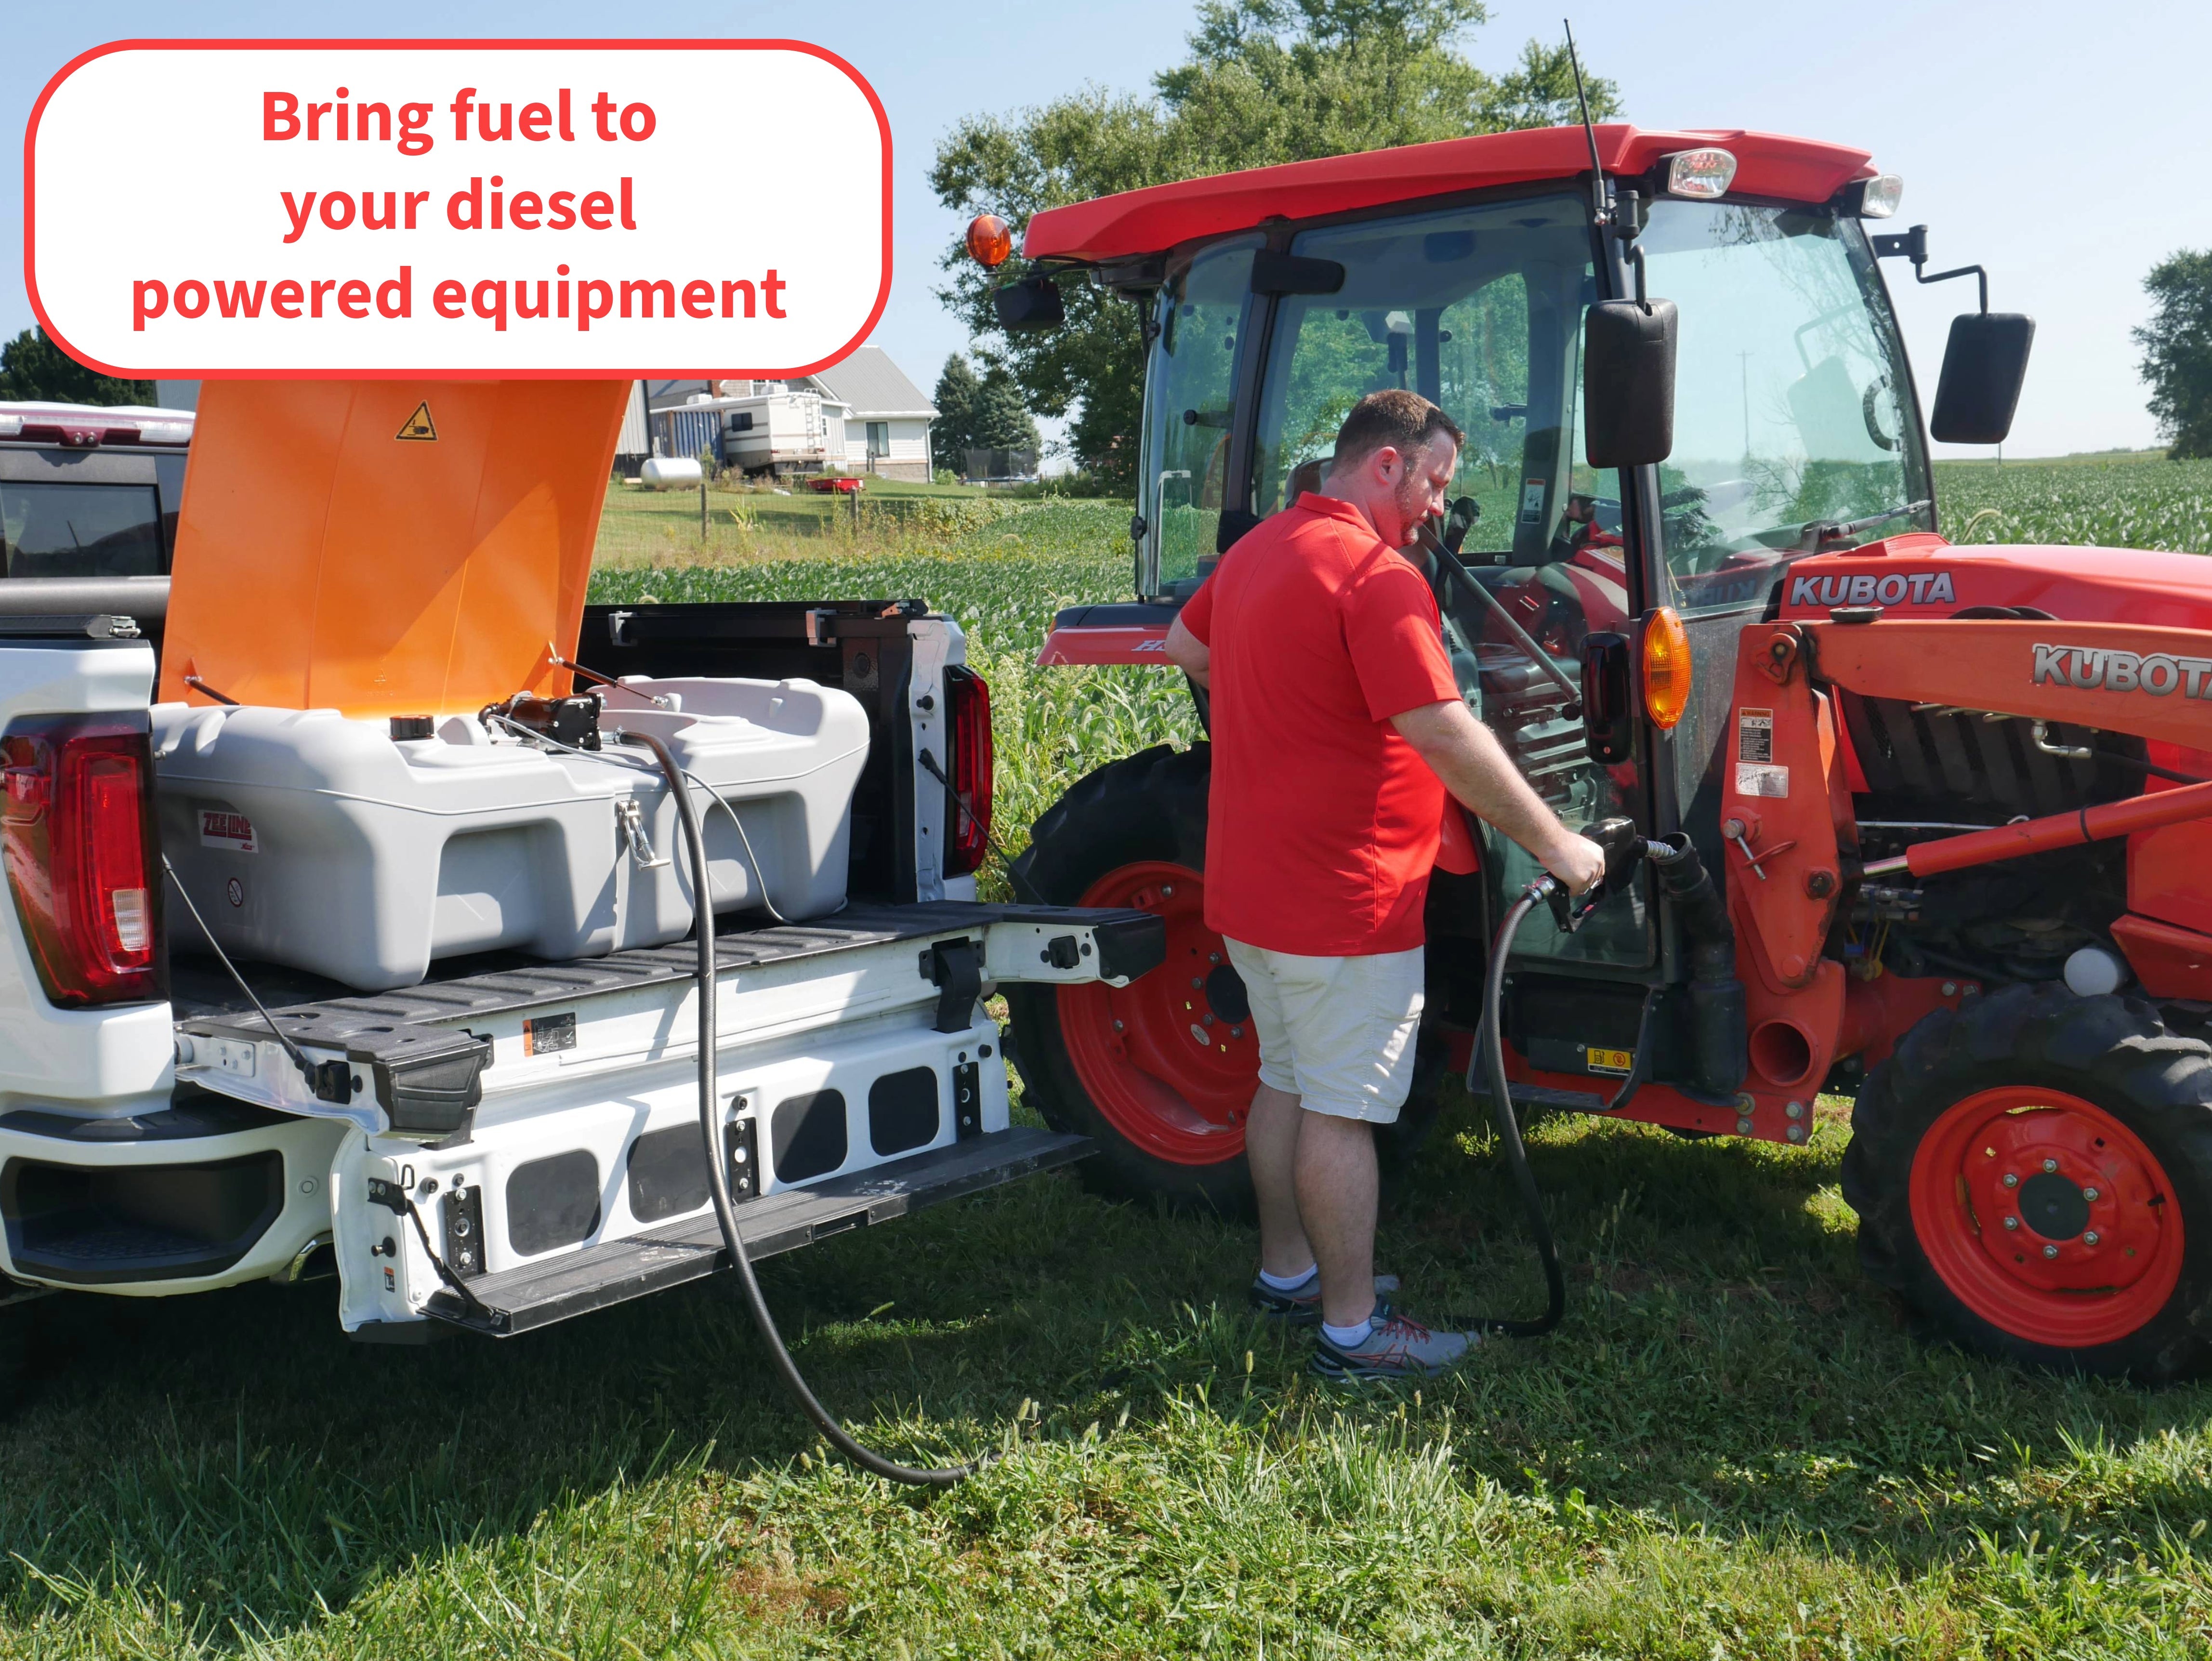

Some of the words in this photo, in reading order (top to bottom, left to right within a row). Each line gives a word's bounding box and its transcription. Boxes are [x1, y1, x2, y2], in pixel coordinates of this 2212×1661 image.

[1790, 572, 1956, 606] KUBOTA
[2032, 645, 2212, 701] KUBOT
[203, 812, 226, 838] ZEE
[227, 814, 252, 841] LINE
